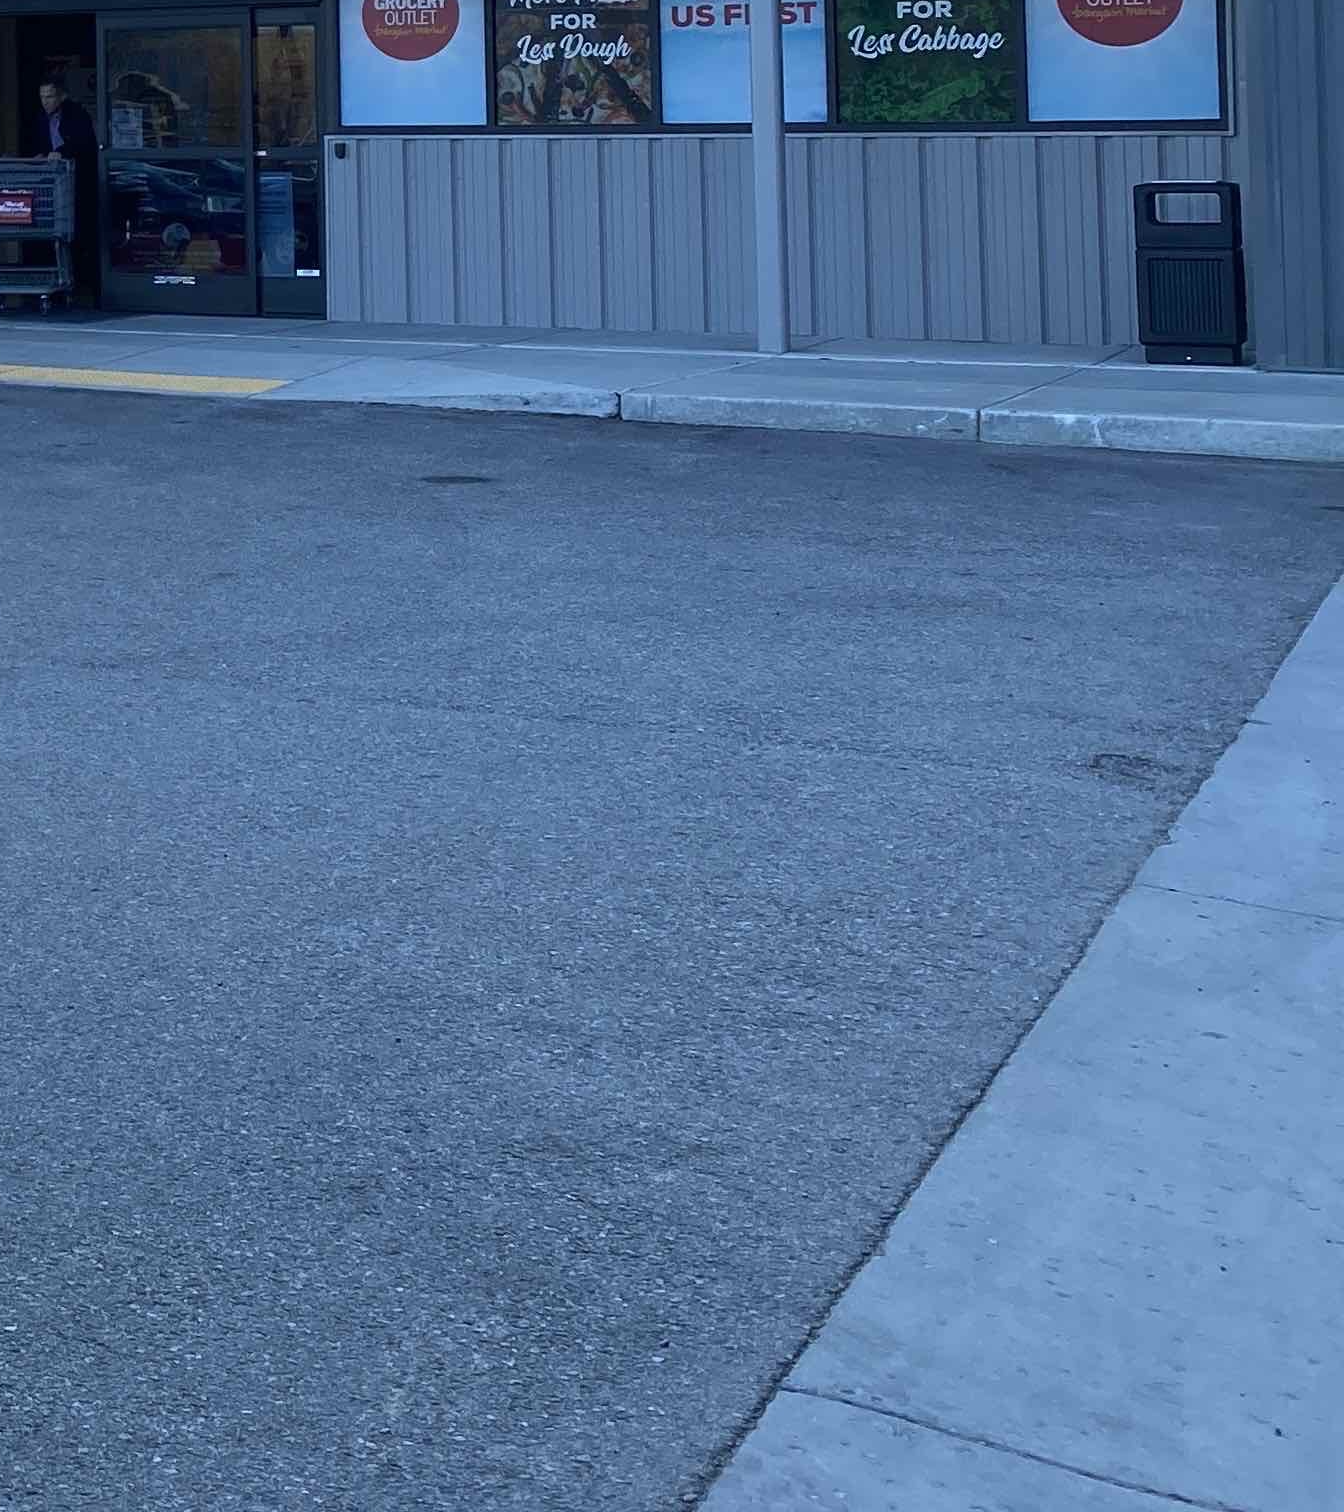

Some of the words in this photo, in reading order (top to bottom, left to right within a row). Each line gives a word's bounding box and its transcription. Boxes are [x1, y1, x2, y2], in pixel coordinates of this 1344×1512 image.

[384, 9, 437, 26] OUTLET
[671, 4, 715, 28] US
[724, 1, 817, 26] FIST
[896, 0, 953, 19] FOR
[550, 13, 597, 30] FOR
[516, 34, 556, 65] Less
[559, 33, 632, 65] Dough
[847, 24, 895, 59] Less
[898, 24, 1005, 59] Cabbage
